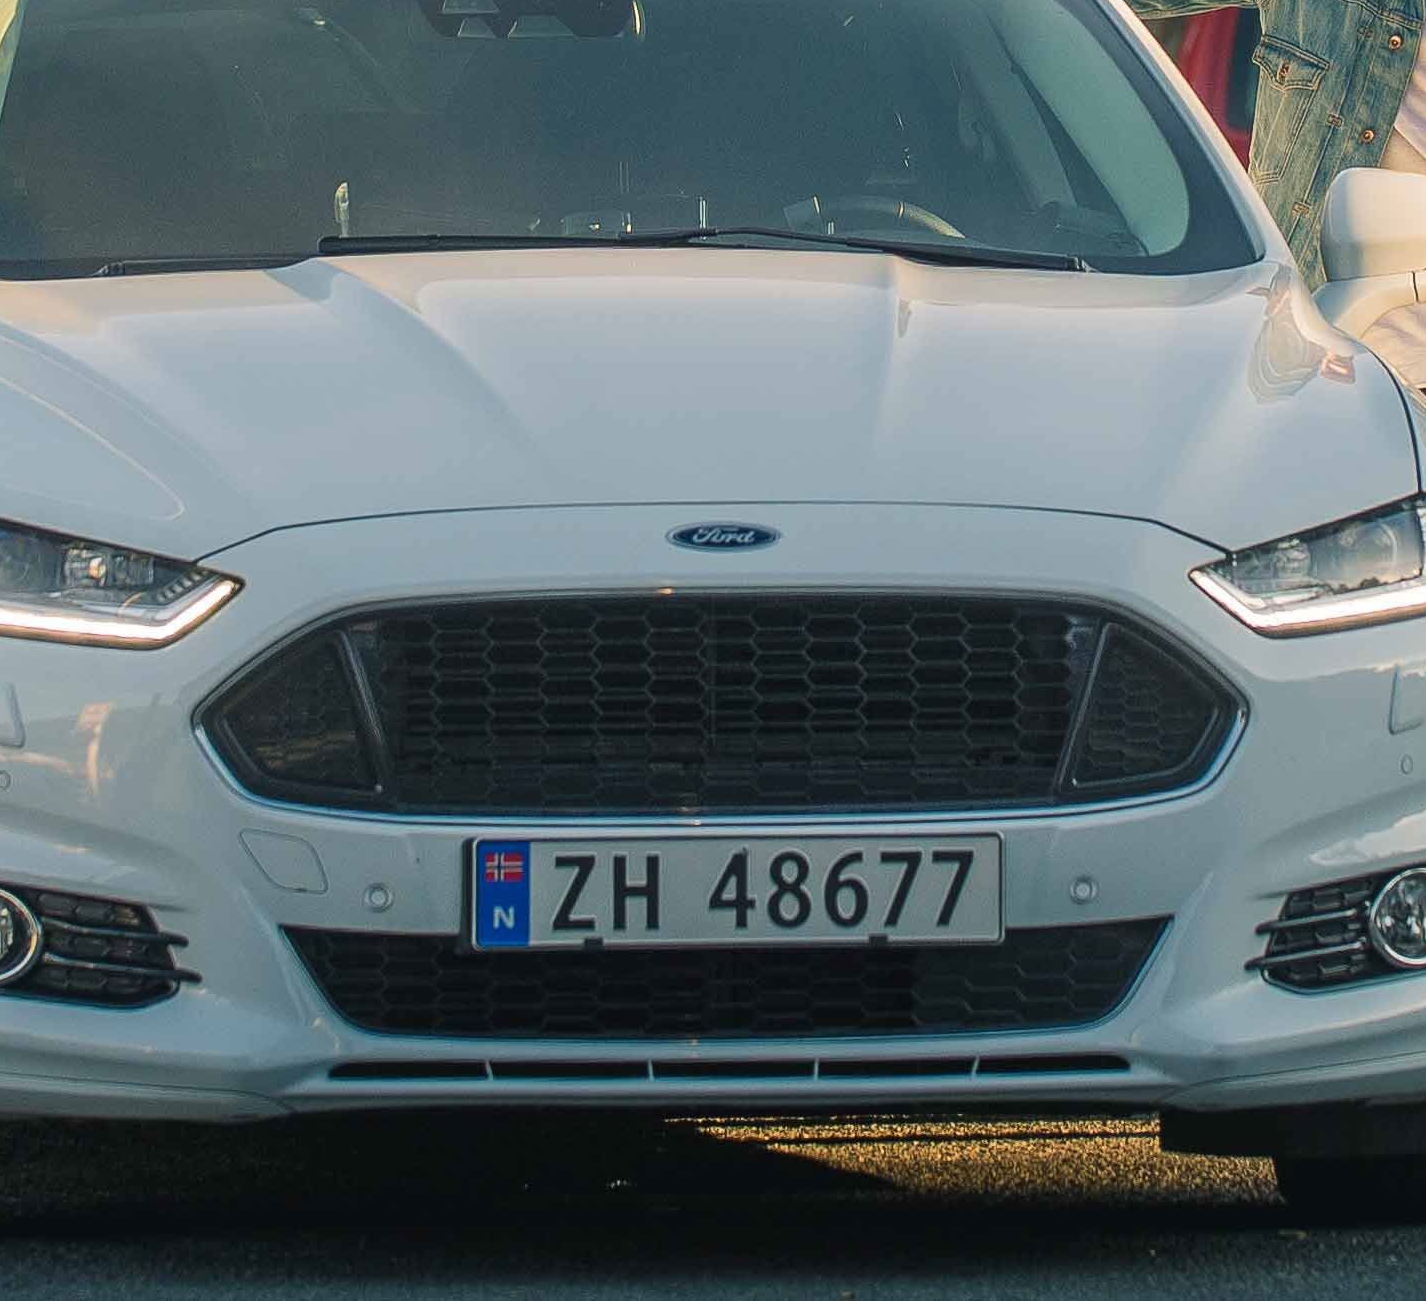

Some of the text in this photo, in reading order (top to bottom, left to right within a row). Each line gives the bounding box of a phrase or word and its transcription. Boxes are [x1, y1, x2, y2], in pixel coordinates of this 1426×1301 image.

[692, 527, 756, 543] Ford
[493, 848, 976, 932] N ZH 48677
